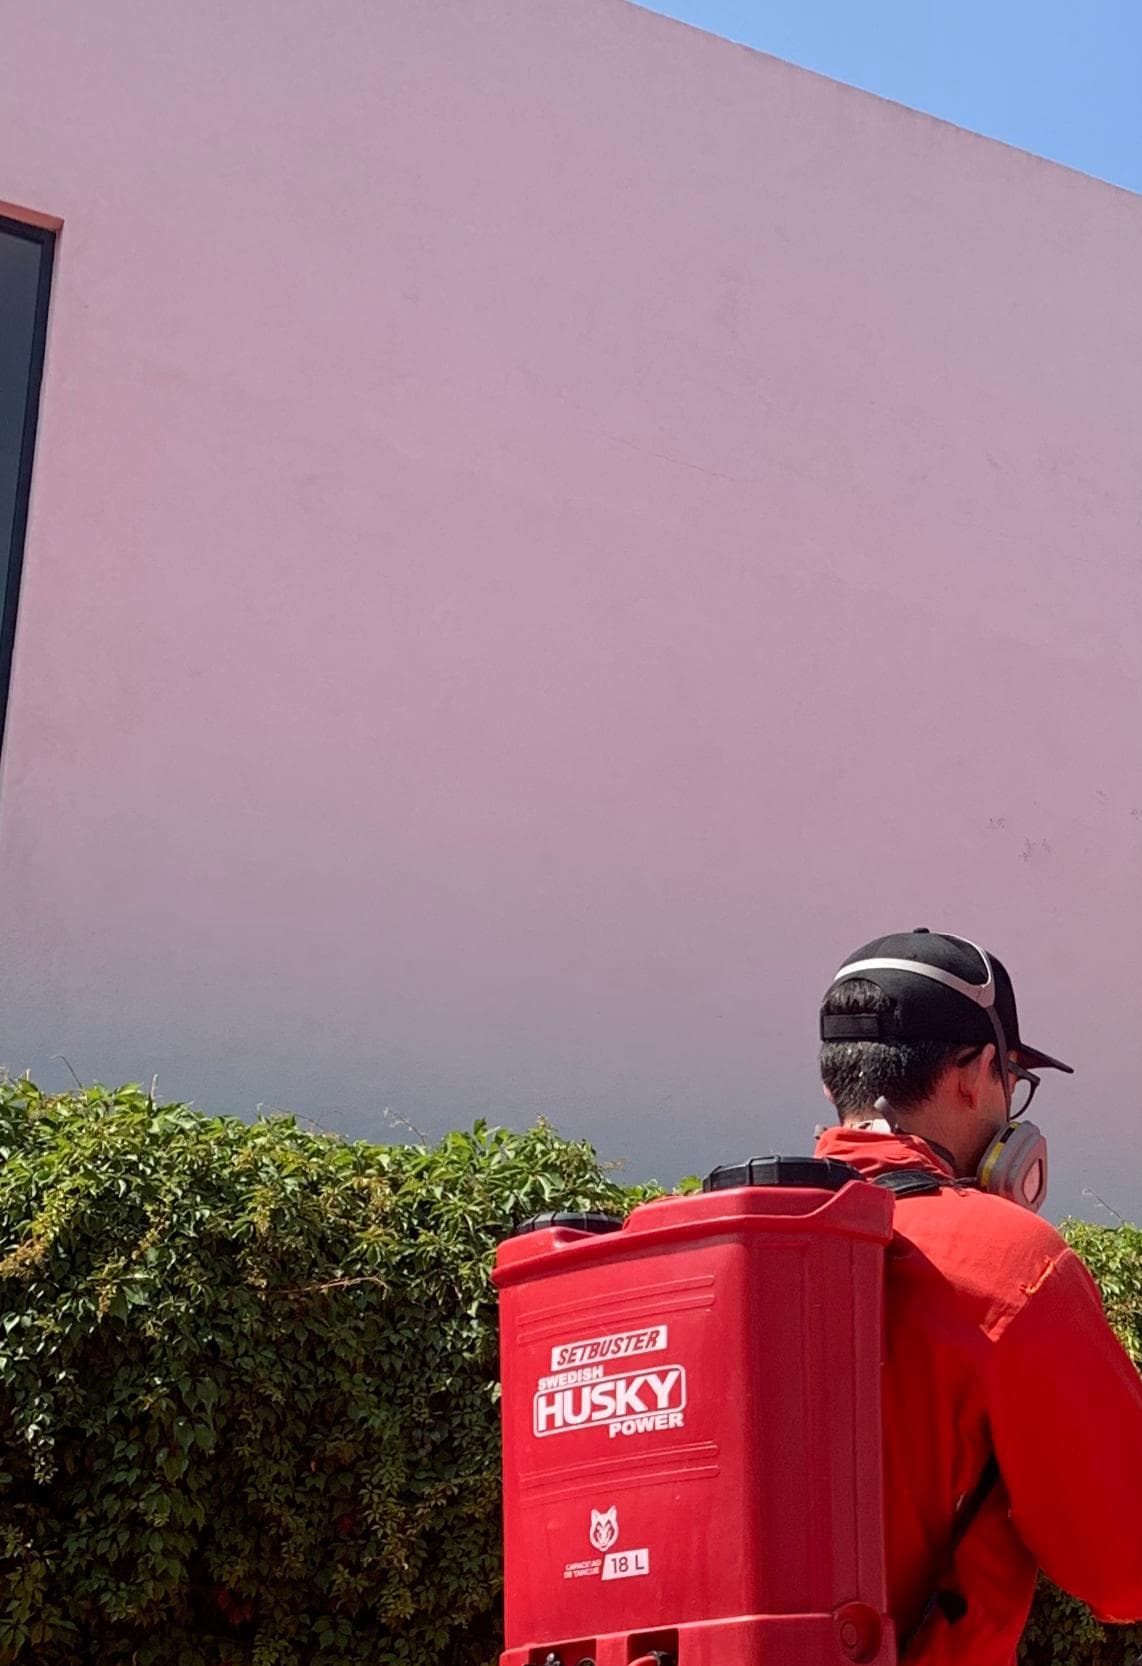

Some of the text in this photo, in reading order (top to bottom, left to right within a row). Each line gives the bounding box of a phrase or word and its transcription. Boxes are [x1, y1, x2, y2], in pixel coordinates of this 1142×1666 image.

[556, 1330, 660, 1366] SETBUSTER
[537, 1365, 604, 1391] SWEDISH
[537, 1370, 680, 1431] HUSKY
[609, 1412, 686, 1439] POWER
[611, 1554, 645, 1574] 18 L
